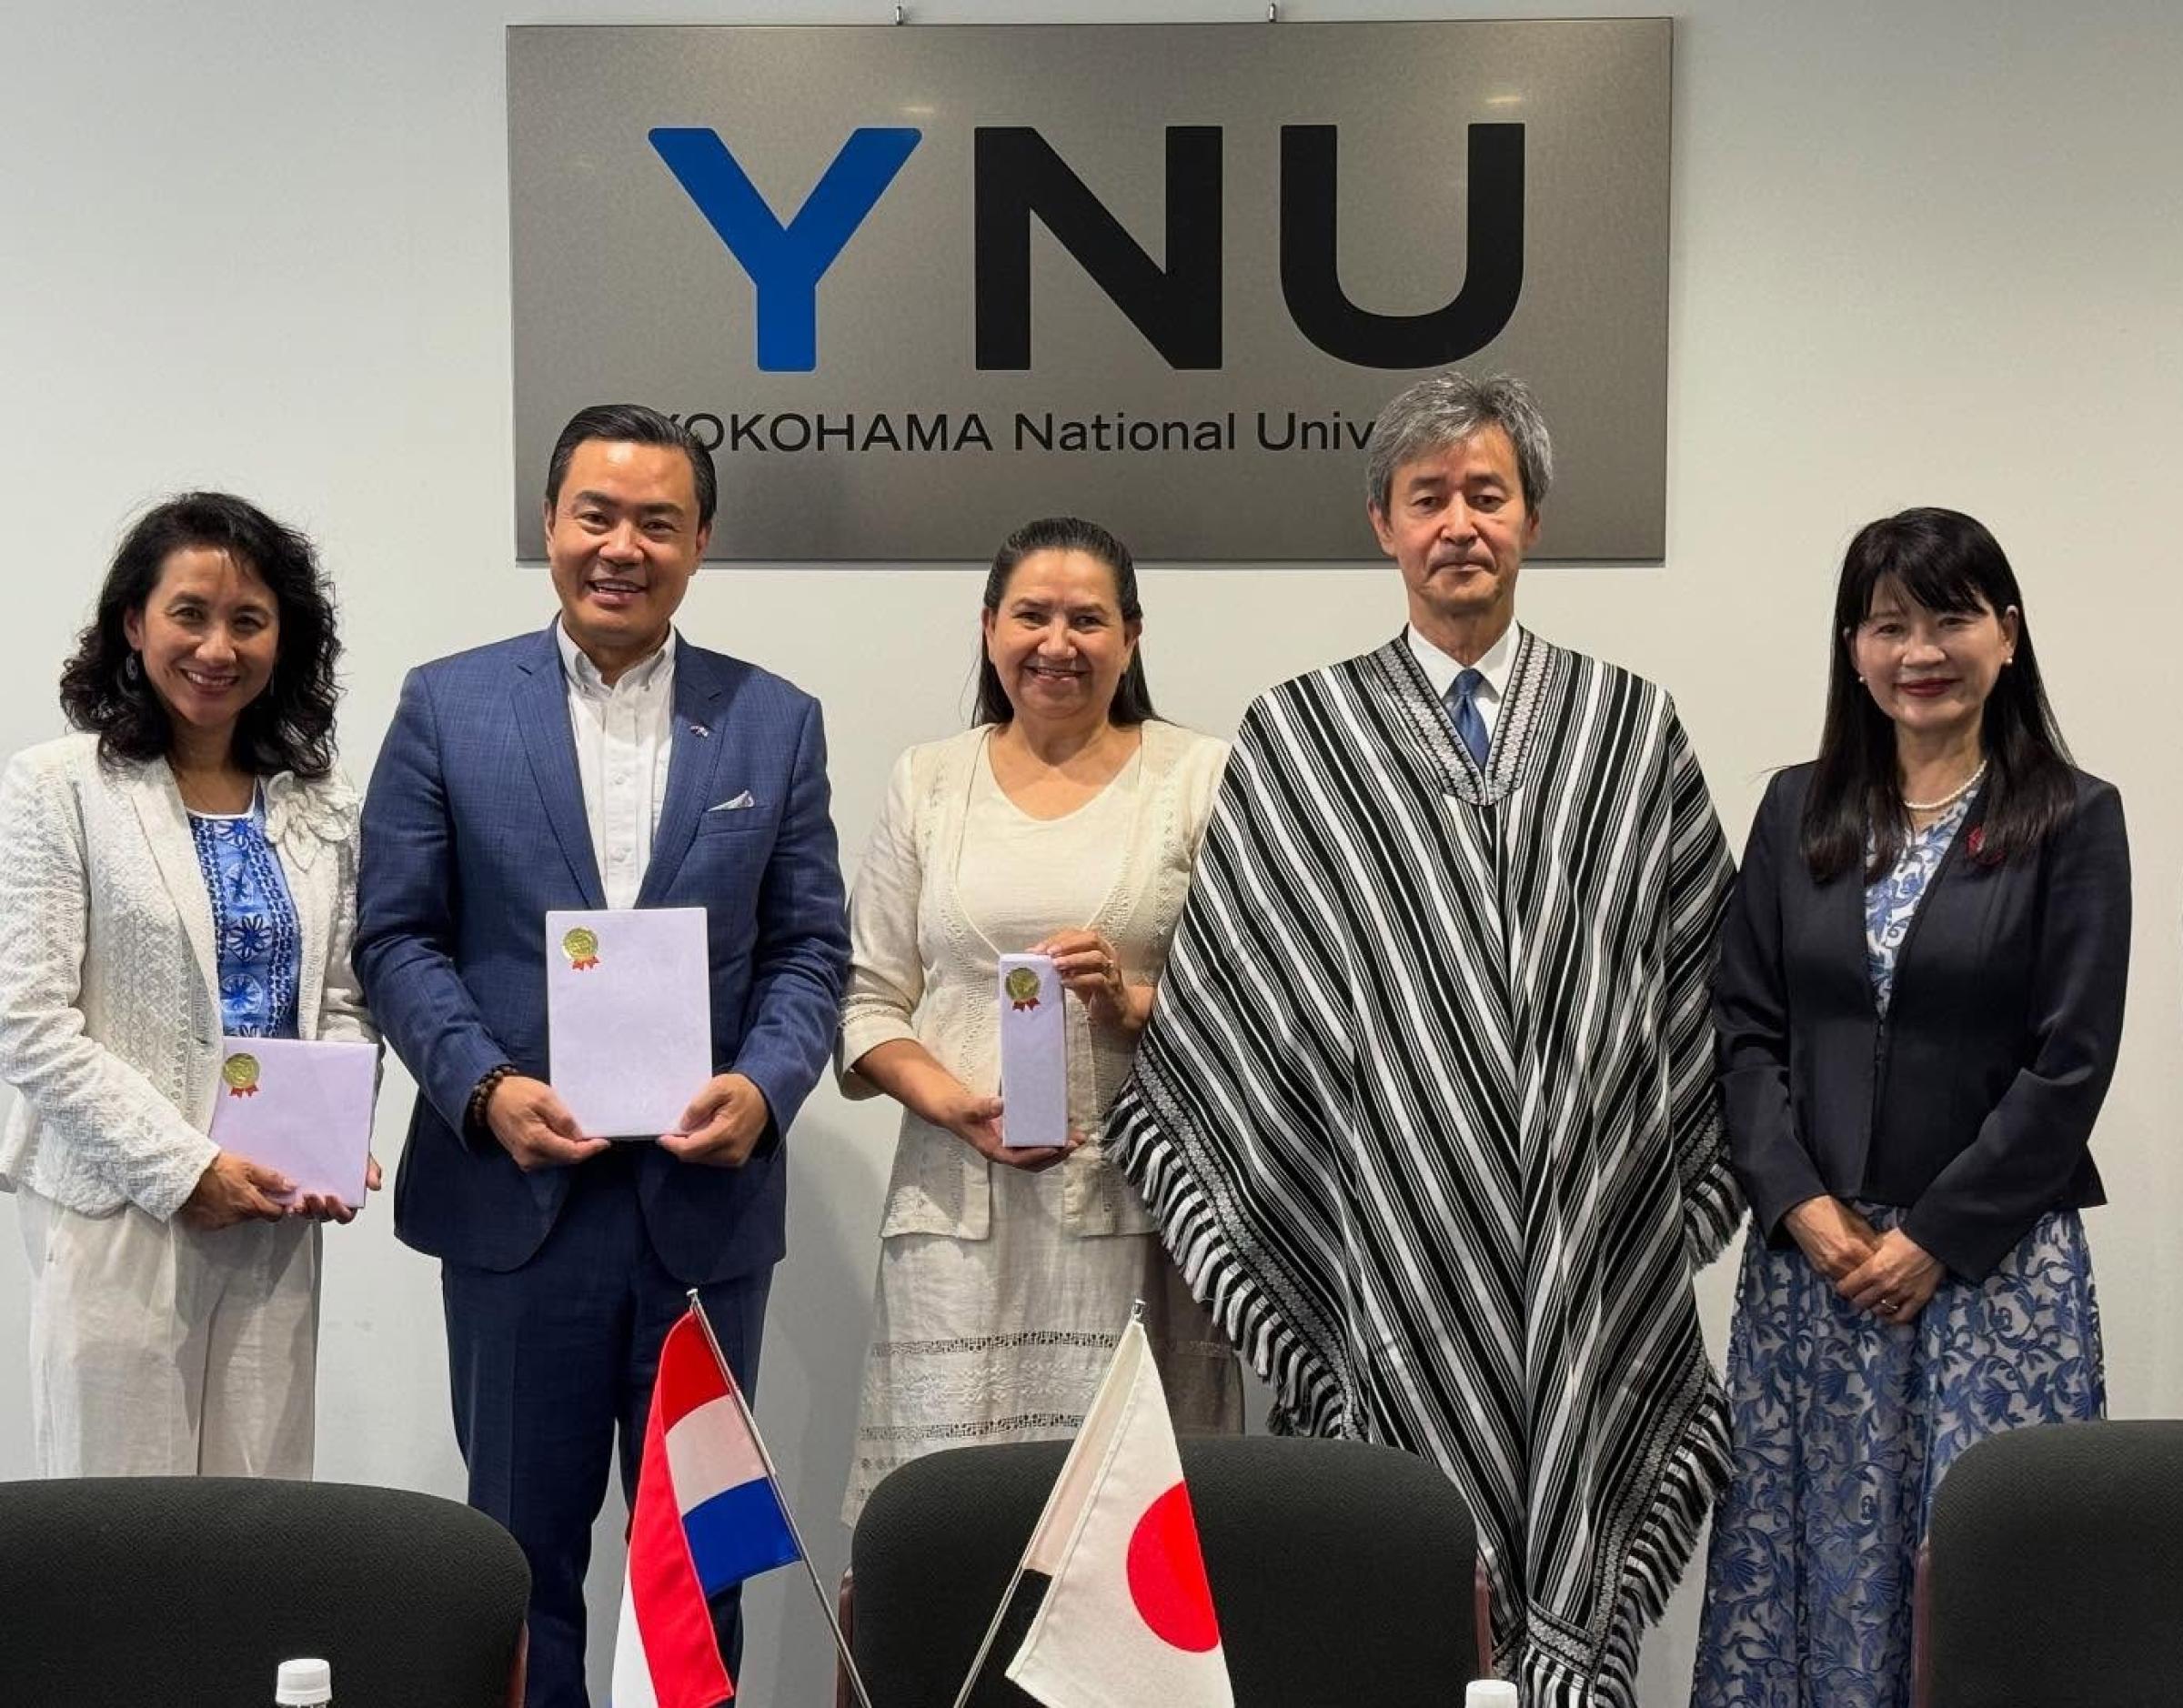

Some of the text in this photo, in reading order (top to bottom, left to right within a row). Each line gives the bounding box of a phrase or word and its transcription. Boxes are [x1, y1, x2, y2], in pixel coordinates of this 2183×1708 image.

[648, 123, 1525, 372] YNU
[669, 411, 1377, 451] OKOHAMA National Univ
